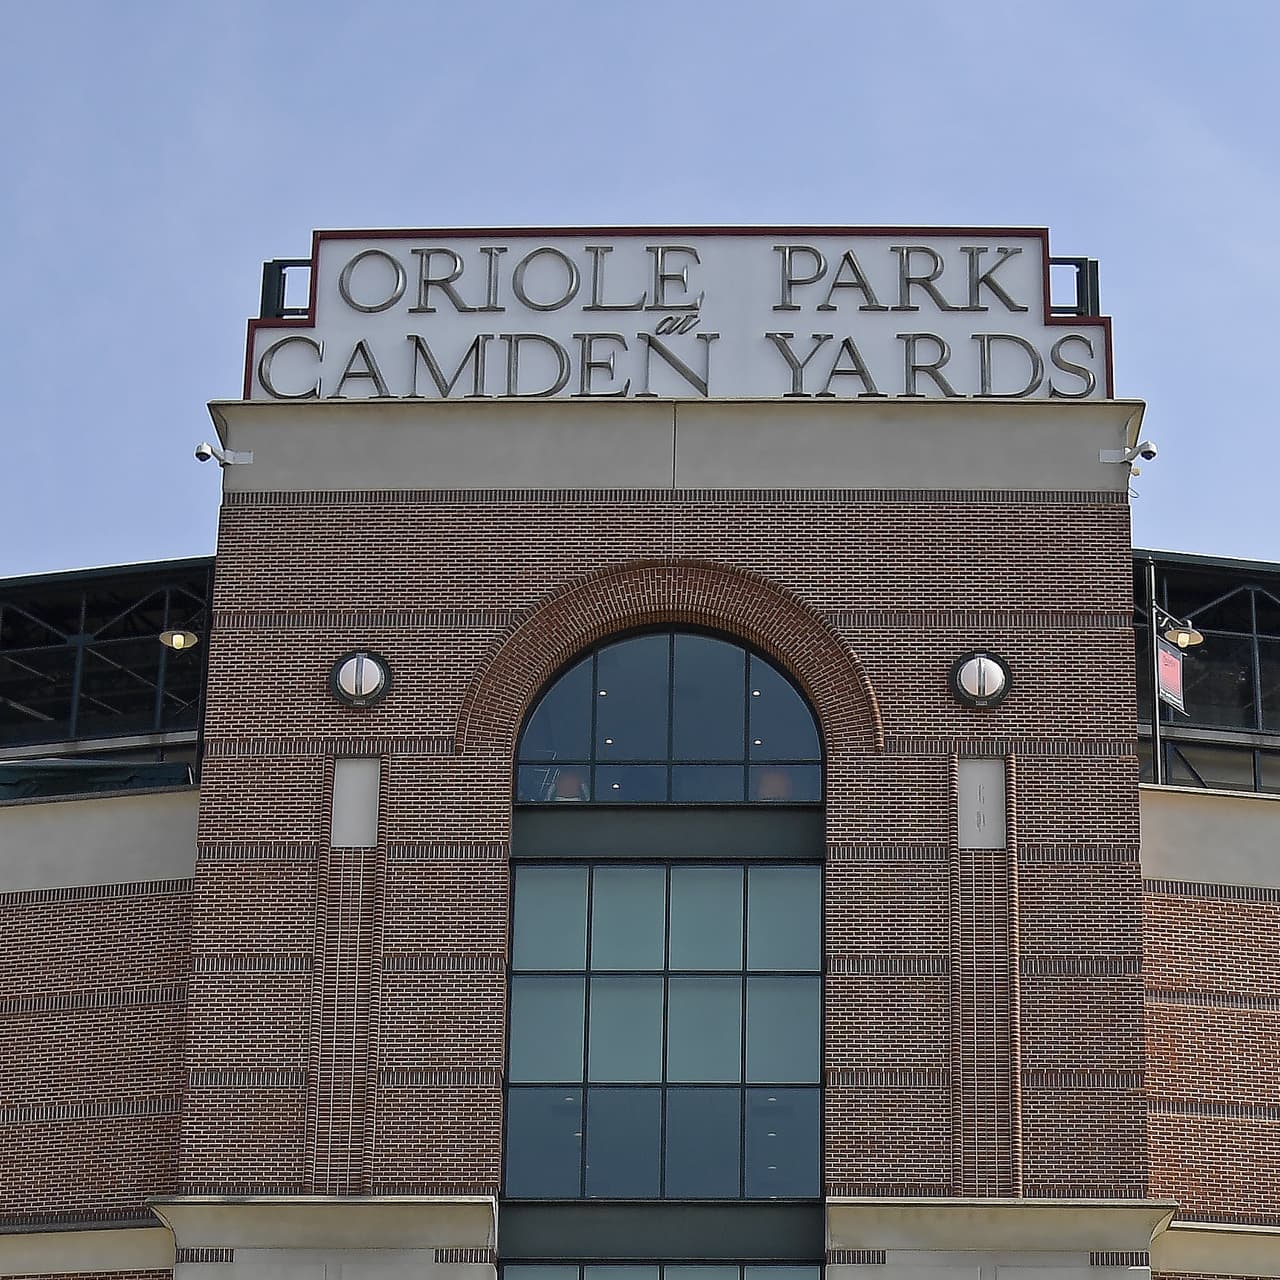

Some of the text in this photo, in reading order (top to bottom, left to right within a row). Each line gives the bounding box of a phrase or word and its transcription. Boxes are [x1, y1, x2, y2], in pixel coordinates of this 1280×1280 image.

[338, 244, 1029, 314] ORIOLE PARK
[655, 314, 701, 336] at
[257, 332, 1097, 400] CAMDEN YARDS
